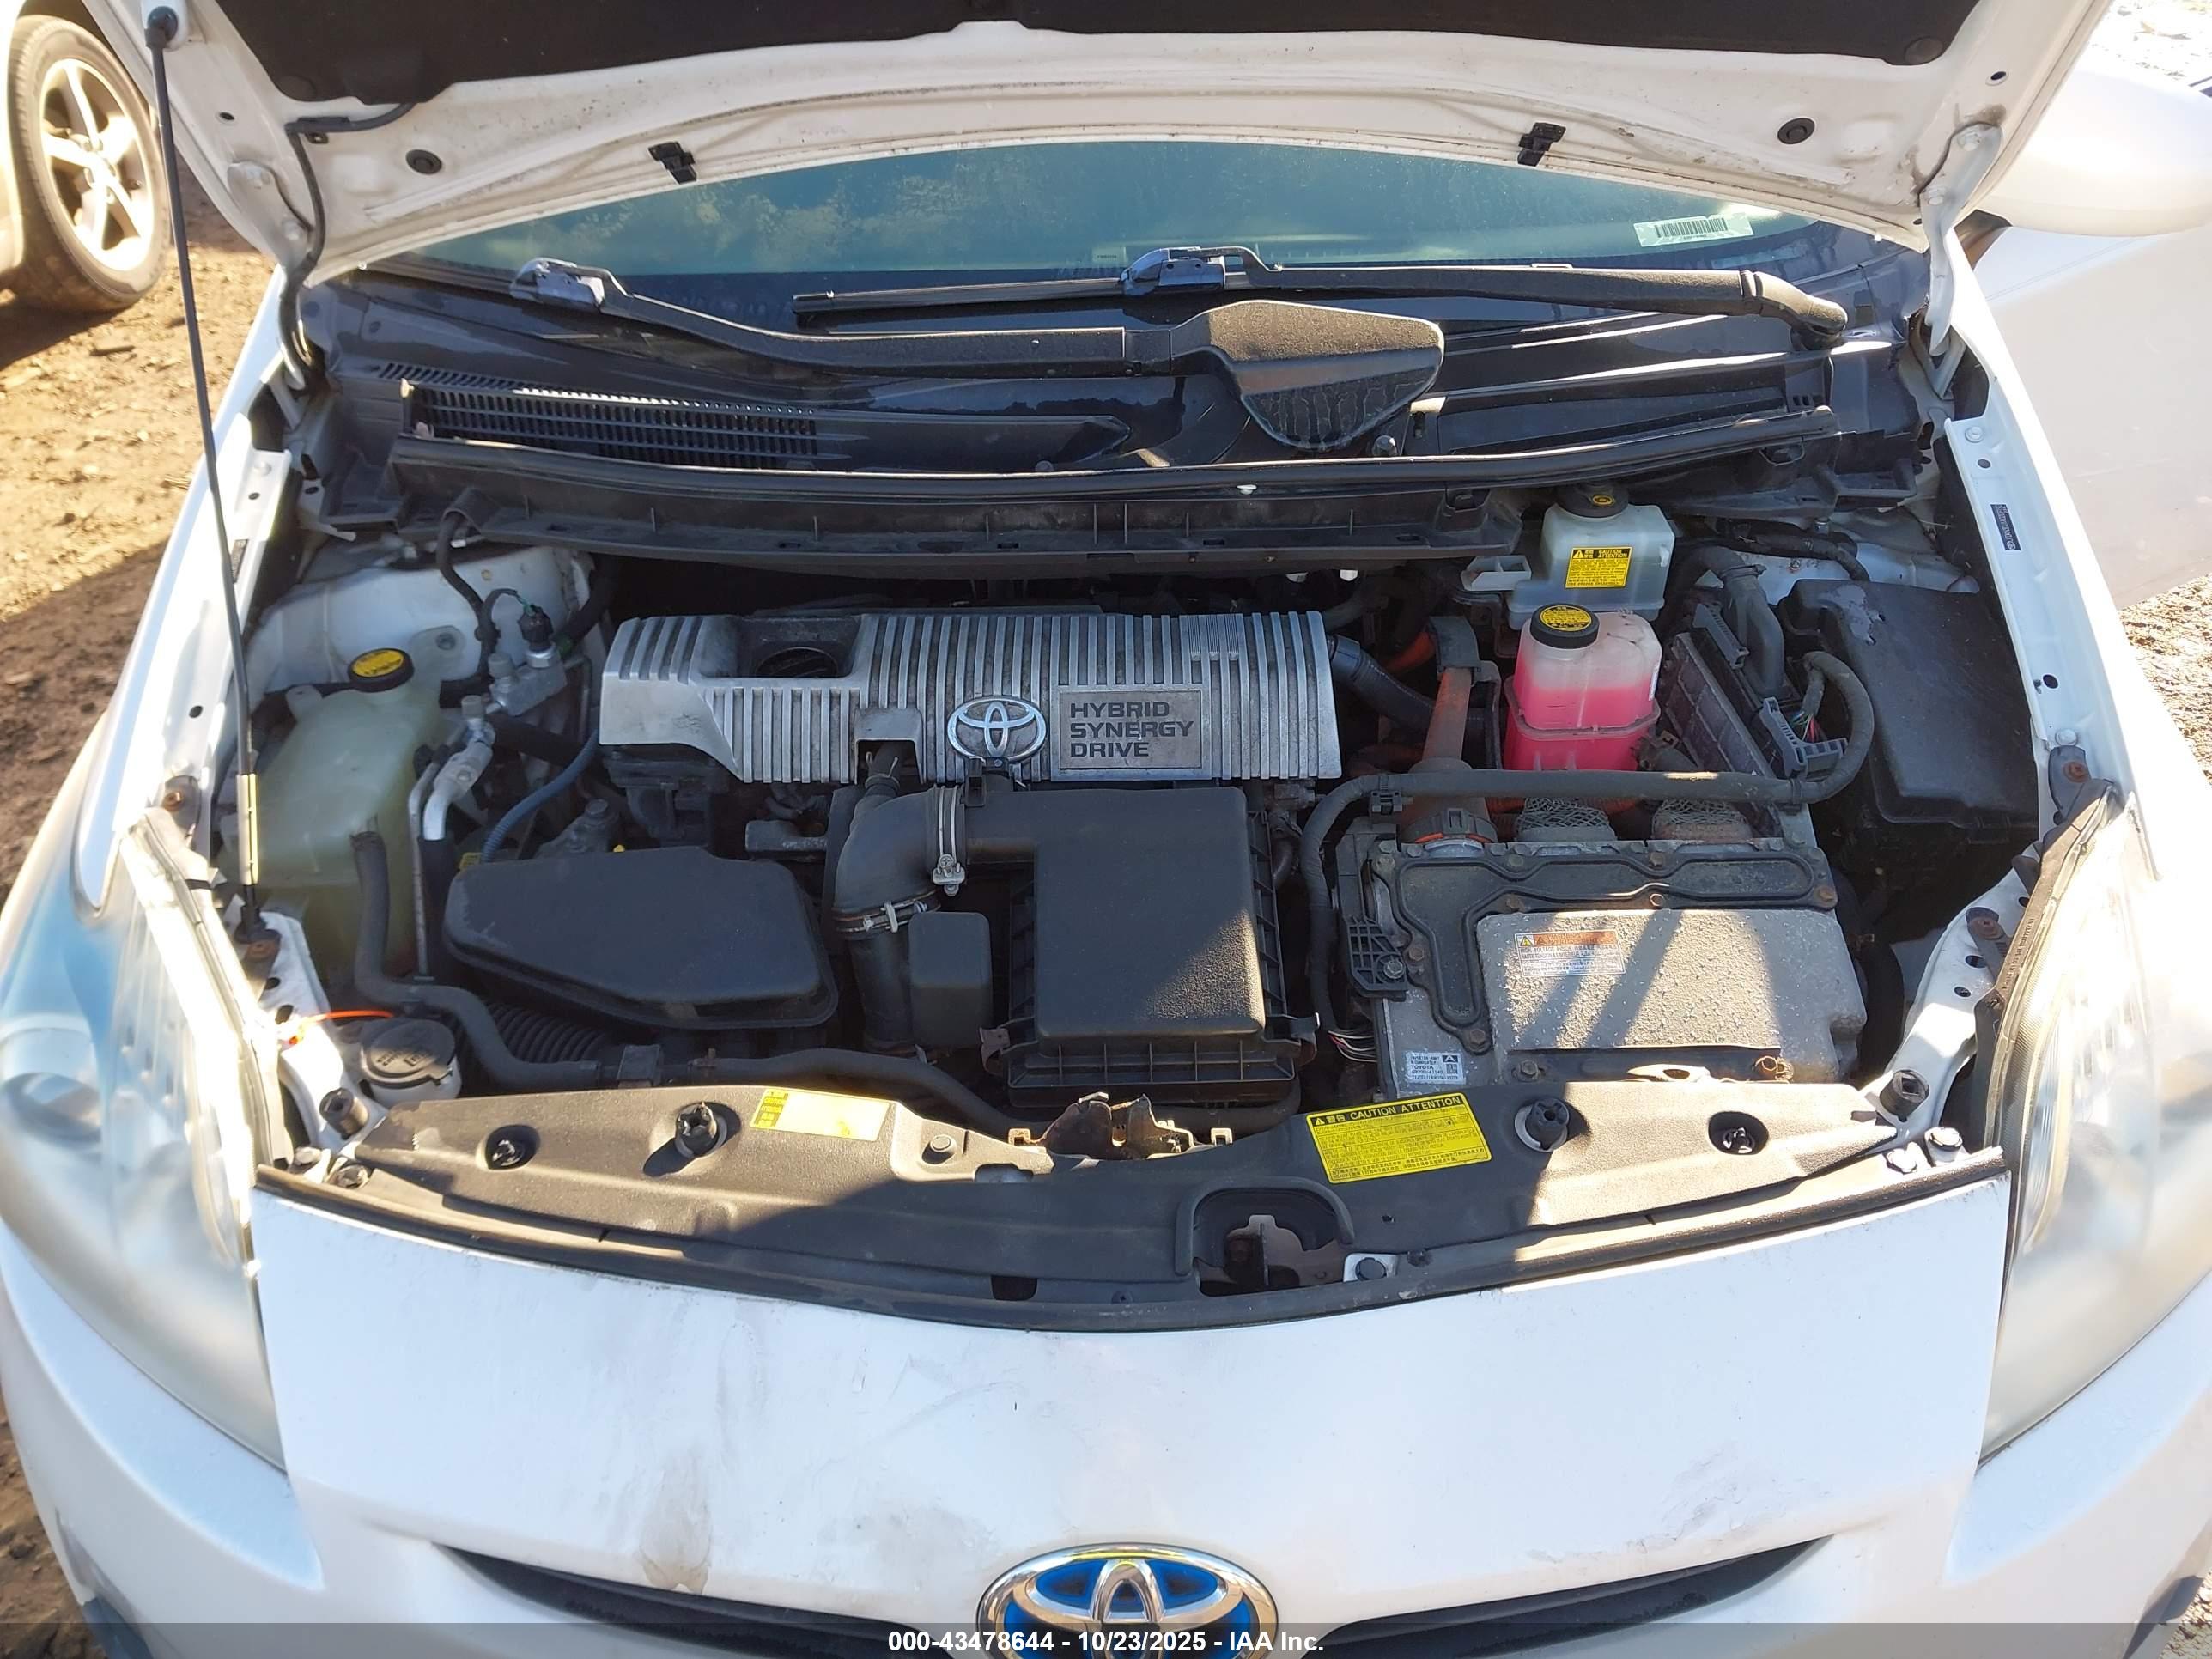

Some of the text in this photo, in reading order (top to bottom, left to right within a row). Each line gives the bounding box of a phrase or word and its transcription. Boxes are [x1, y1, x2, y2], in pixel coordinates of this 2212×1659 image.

[1070, 702, 1170, 719] HYBRID
[1070, 720, 1194, 738] SYNERGY
[1070, 742, 1150, 758] DRIVE
[1349, 1105, 1397, 1121] CAUTION
[1401, 1097, 1462, 1114] ATTENTION
